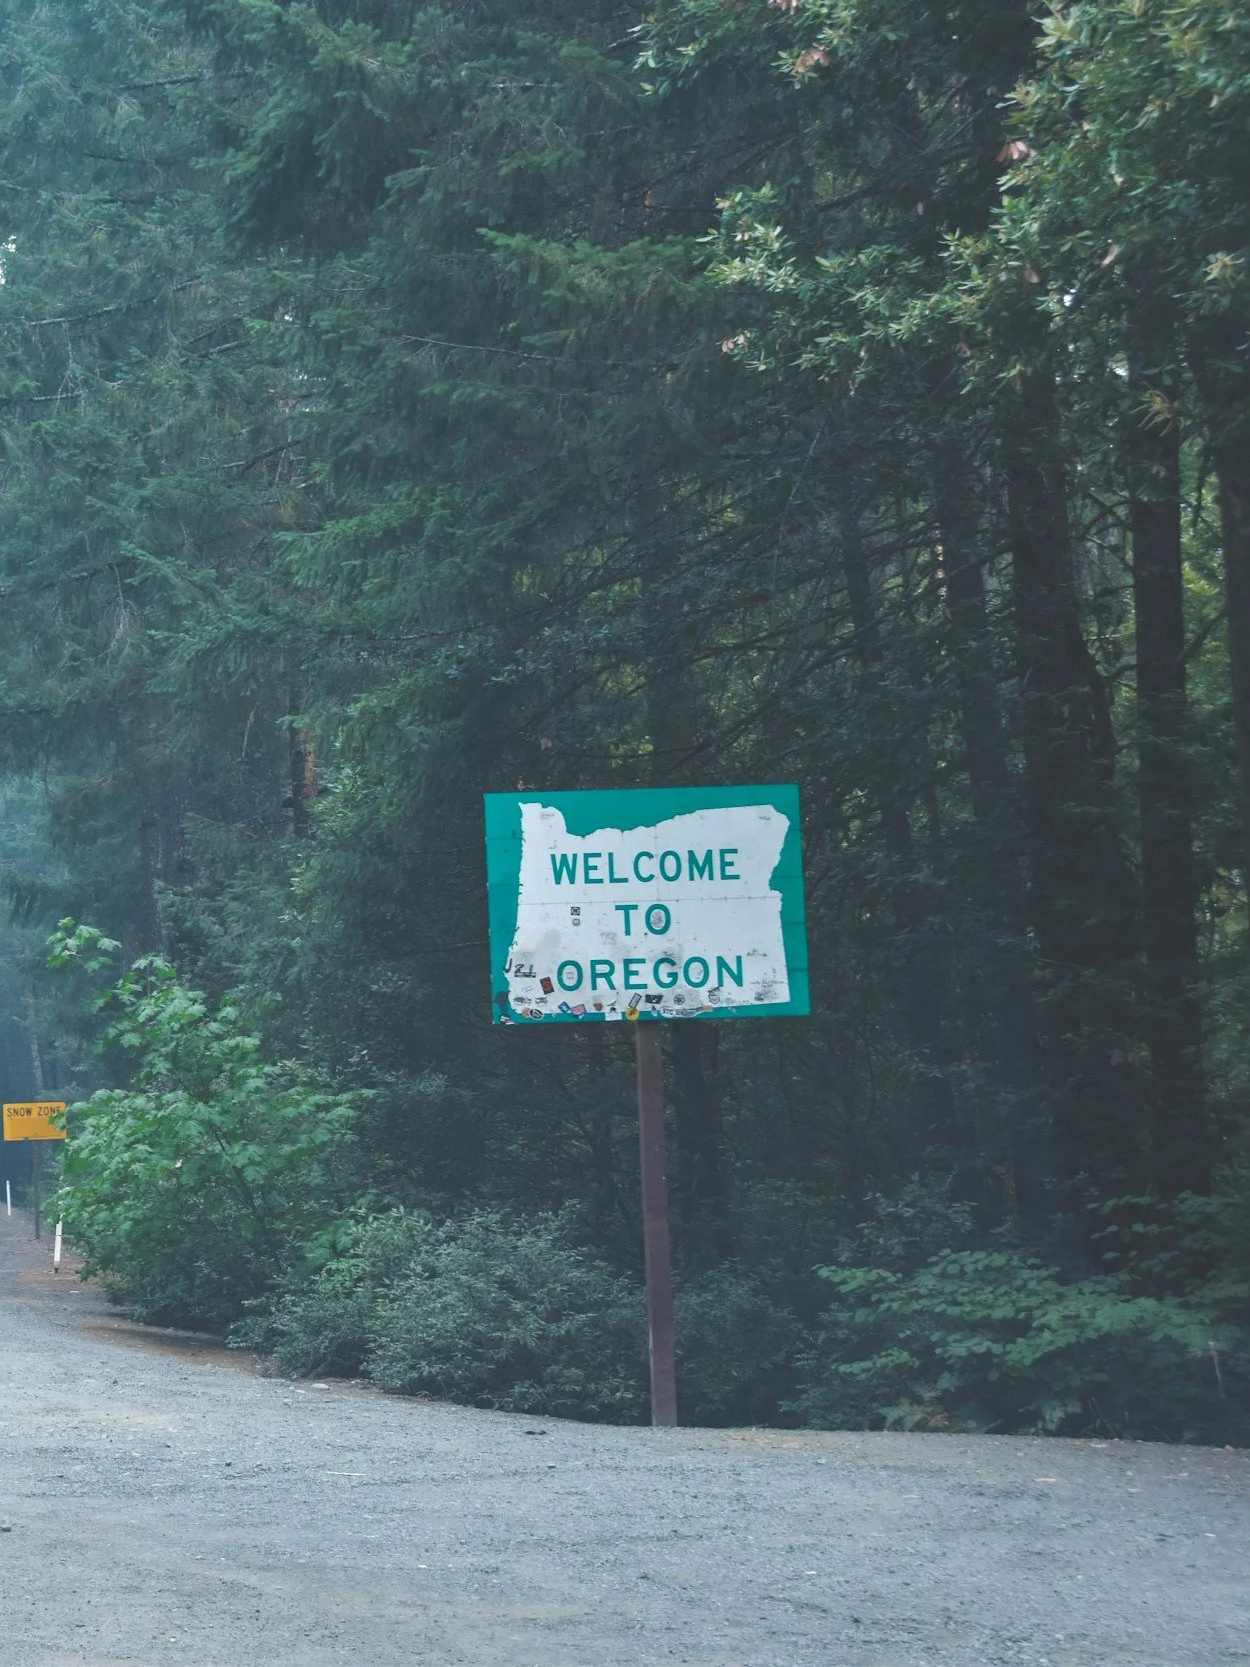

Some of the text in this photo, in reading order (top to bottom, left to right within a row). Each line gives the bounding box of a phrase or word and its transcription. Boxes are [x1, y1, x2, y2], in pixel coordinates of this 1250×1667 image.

[550, 848, 741, 885] WELCOME
[614, 903, 672, 936] TO
[556, 955, 744, 992] OREGON
[7, 1107, 33, 1117] SNOW
